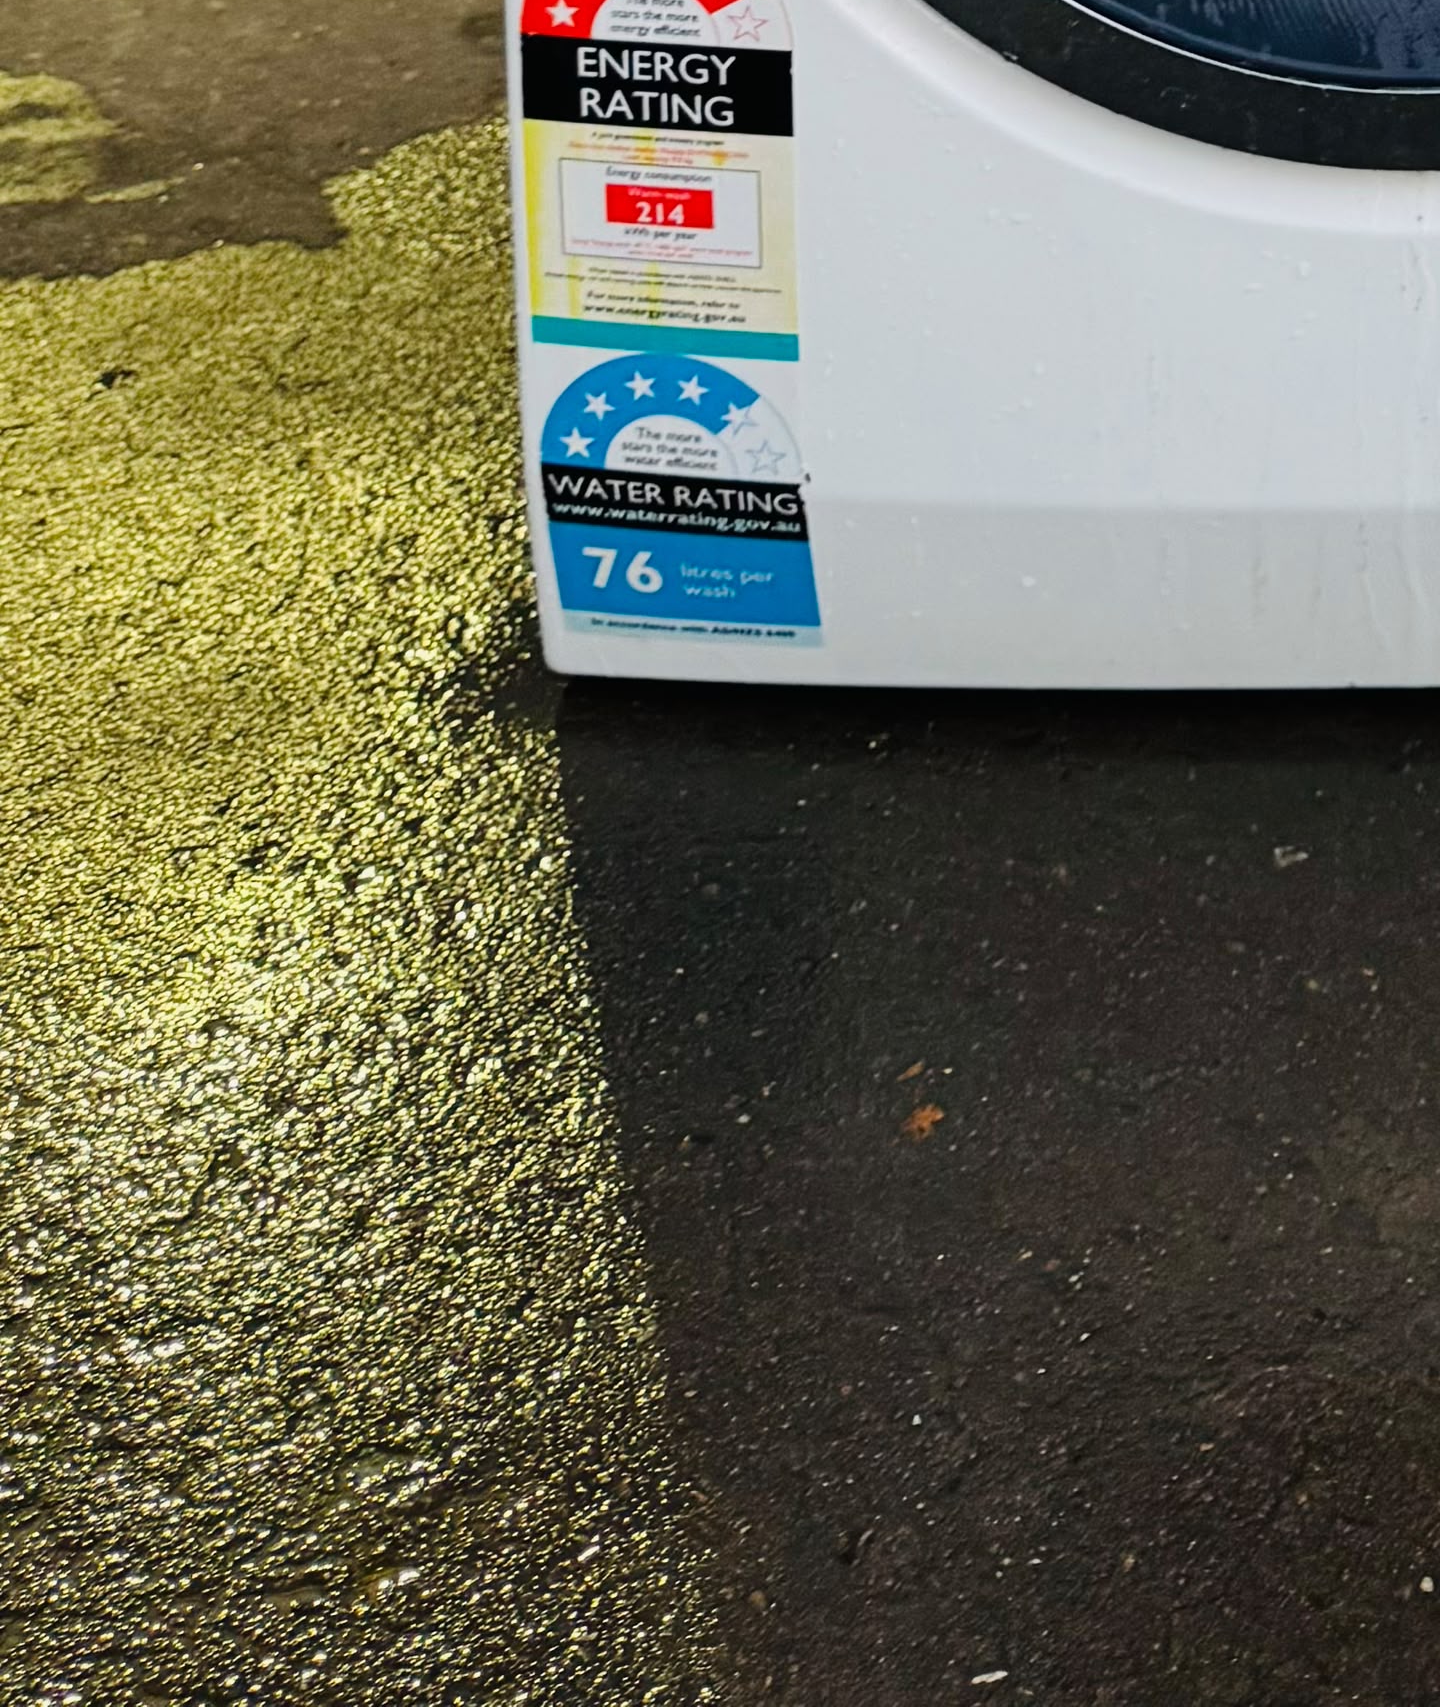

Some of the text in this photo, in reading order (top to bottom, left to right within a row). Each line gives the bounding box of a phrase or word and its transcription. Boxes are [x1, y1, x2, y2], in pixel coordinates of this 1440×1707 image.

[643, 11, 662, 20] the
[666, 13, 698, 22] more
[576, 47, 736, 86] ENERGY
[580, 87, 734, 127] RATING
[605, 166, 712, 183] Energy consumption
[636, 202, 685, 224] 214
[636, 427, 702, 443] The more
[624, 456, 661, 465] water
[656, 444, 677, 454] the
[682, 448, 718, 457] more
[549, 474, 799, 515] WATER RATING
[552, 503, 801, 533] www.waterrating.gov.au
[582, 546, 663, 594] 76
[680, 562, 774, 584] litres per
[684, 585, 736, 599] wash
